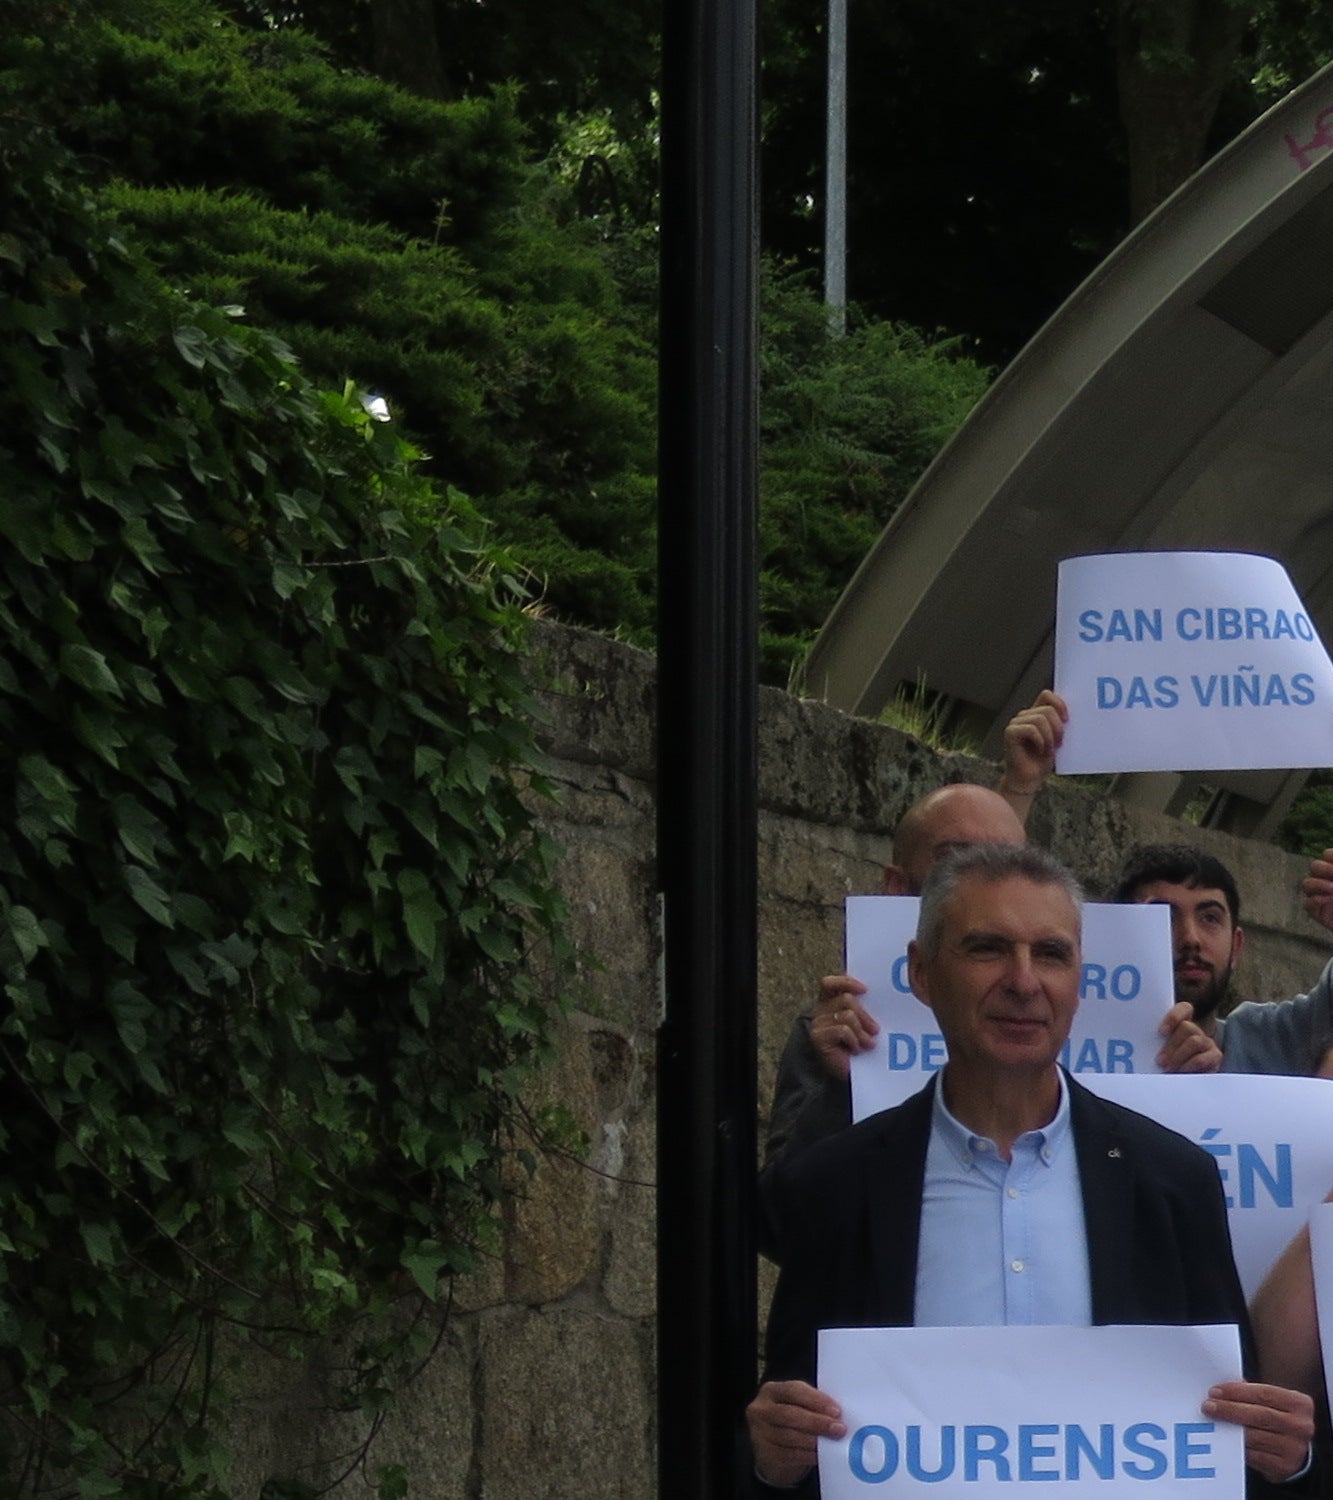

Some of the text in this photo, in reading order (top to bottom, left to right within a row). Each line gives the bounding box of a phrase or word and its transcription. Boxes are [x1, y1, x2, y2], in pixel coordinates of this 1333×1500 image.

[1079, 608, 1315, 643] SAN CIBRAO
[1097, 666, 1317, 709] DAS VIÑAS
[888, 1033, 947, 1071] DE
[847, 1422, 1217, 1484] OURENSE
